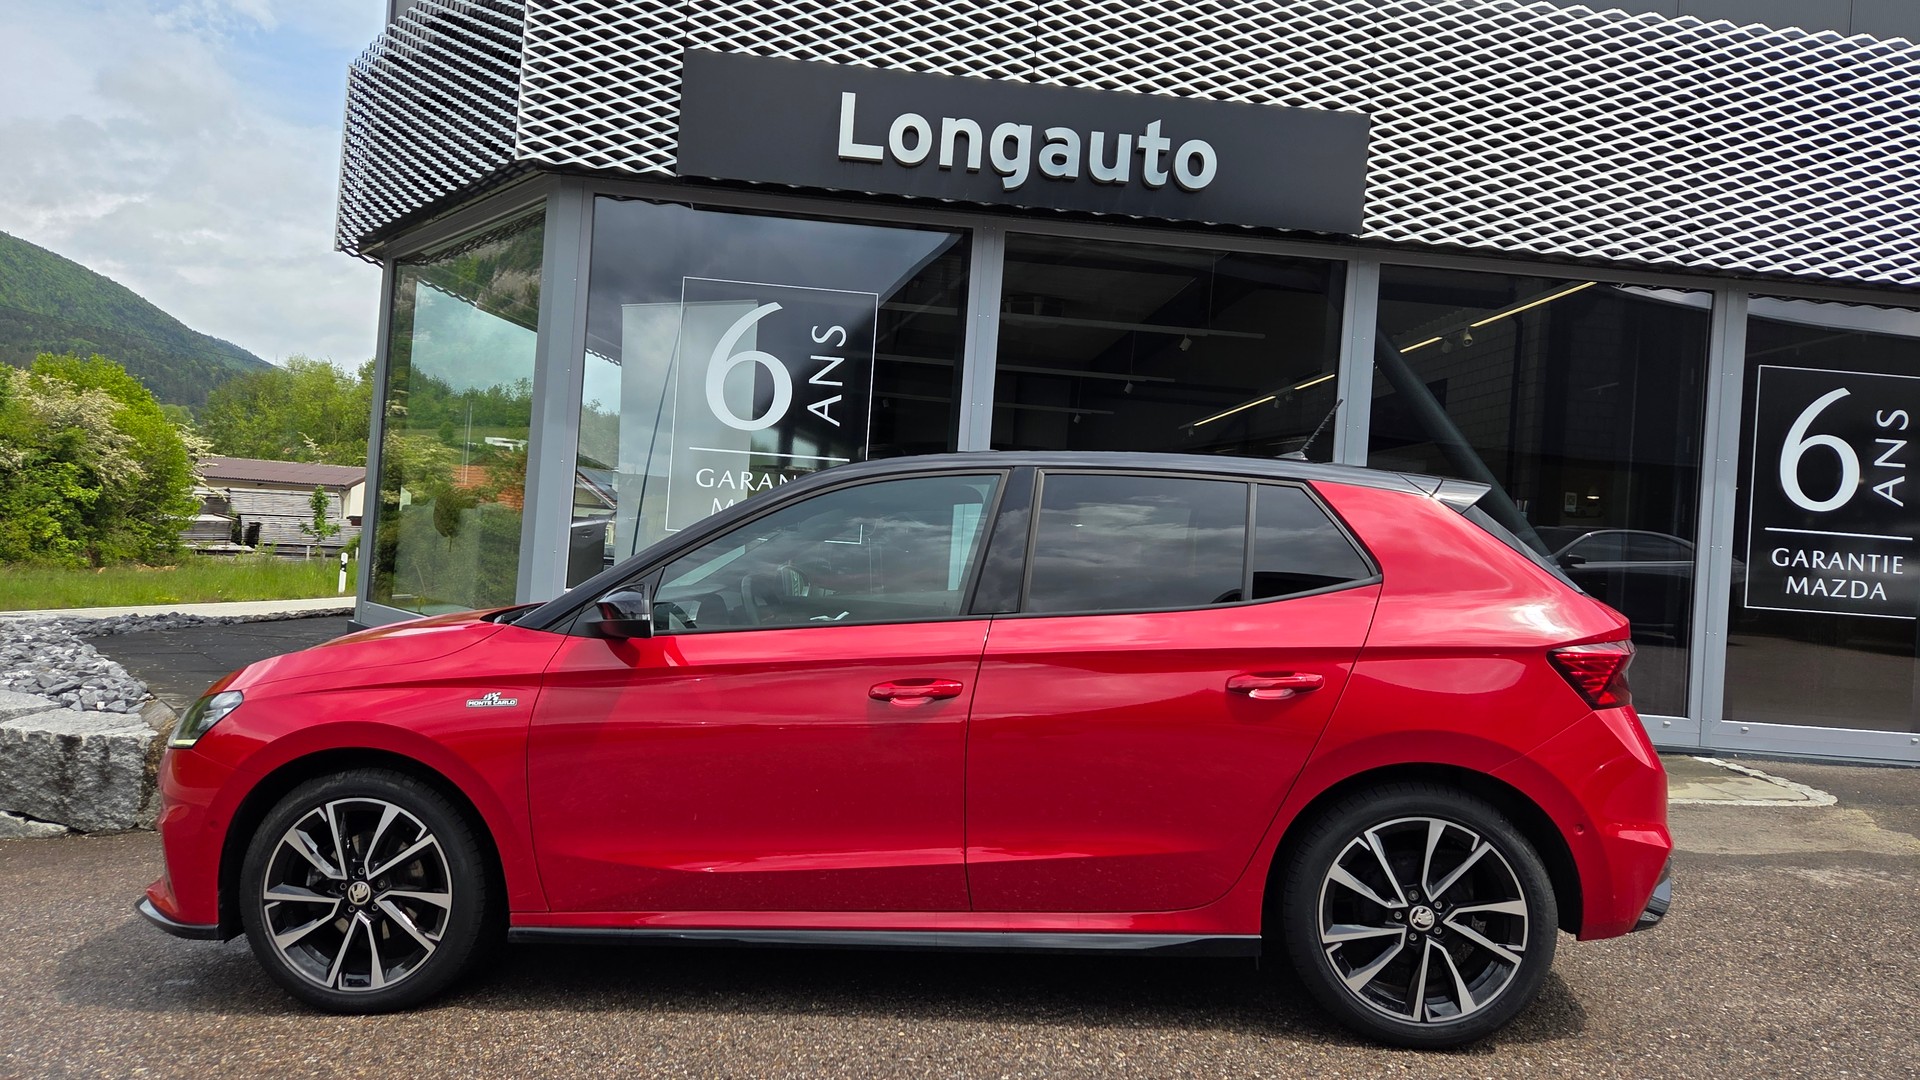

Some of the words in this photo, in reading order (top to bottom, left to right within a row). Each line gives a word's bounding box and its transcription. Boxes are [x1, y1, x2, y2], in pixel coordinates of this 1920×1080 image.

[838, 91, 1218, 192] Longauto
[705, 301, 793, 431] 6
[807, 325, 847, 427] ANS
[1780, 387, 1860, 512] 6
[1872, 409, 1909, 507] ANS
[1771, 547, 1904, 575] GARANTIE
[1785, 576, 1887, 601] MAZDA
